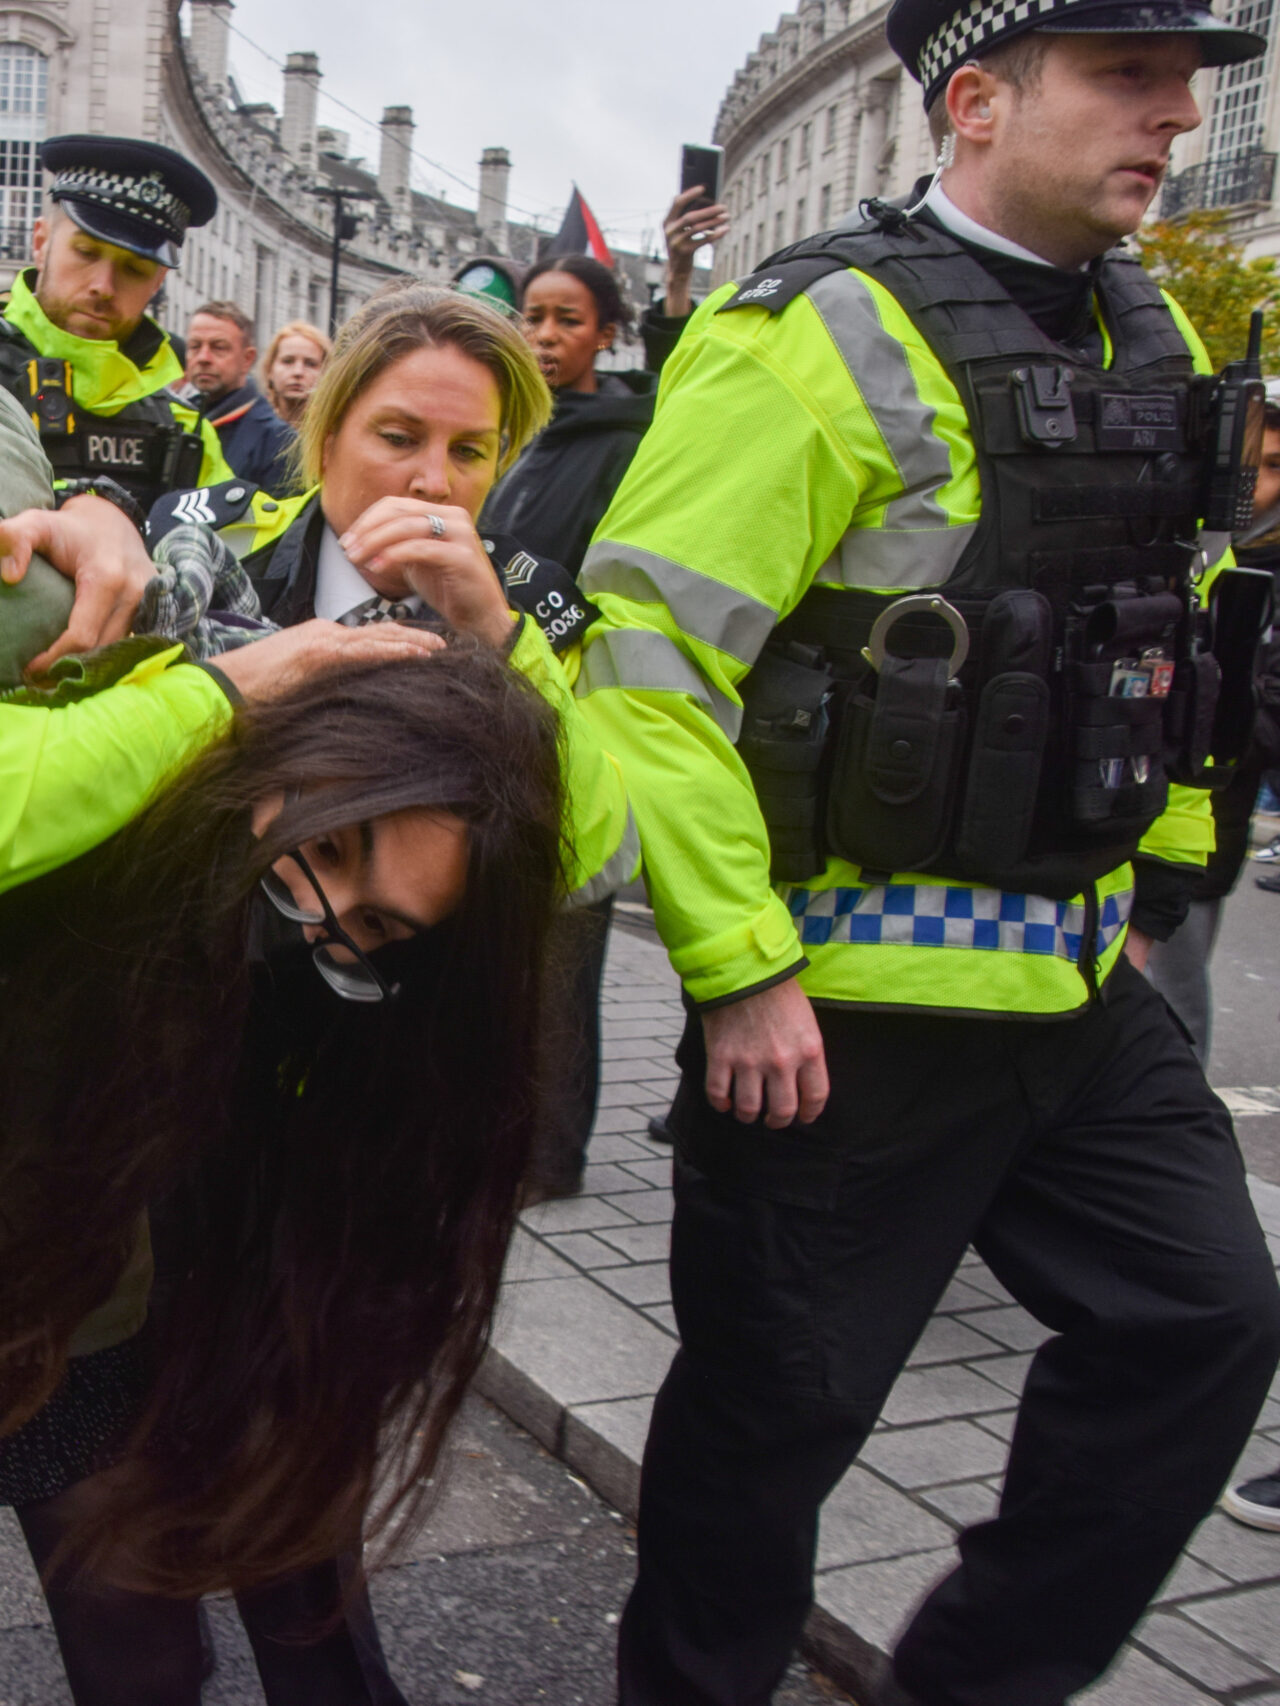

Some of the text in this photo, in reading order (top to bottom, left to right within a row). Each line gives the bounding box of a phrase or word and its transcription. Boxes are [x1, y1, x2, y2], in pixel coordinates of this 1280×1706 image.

[757, 279, 783, 289] CO
[88, 435, 144, 465] POLICE
[544, 604, 585, 643] 5036
